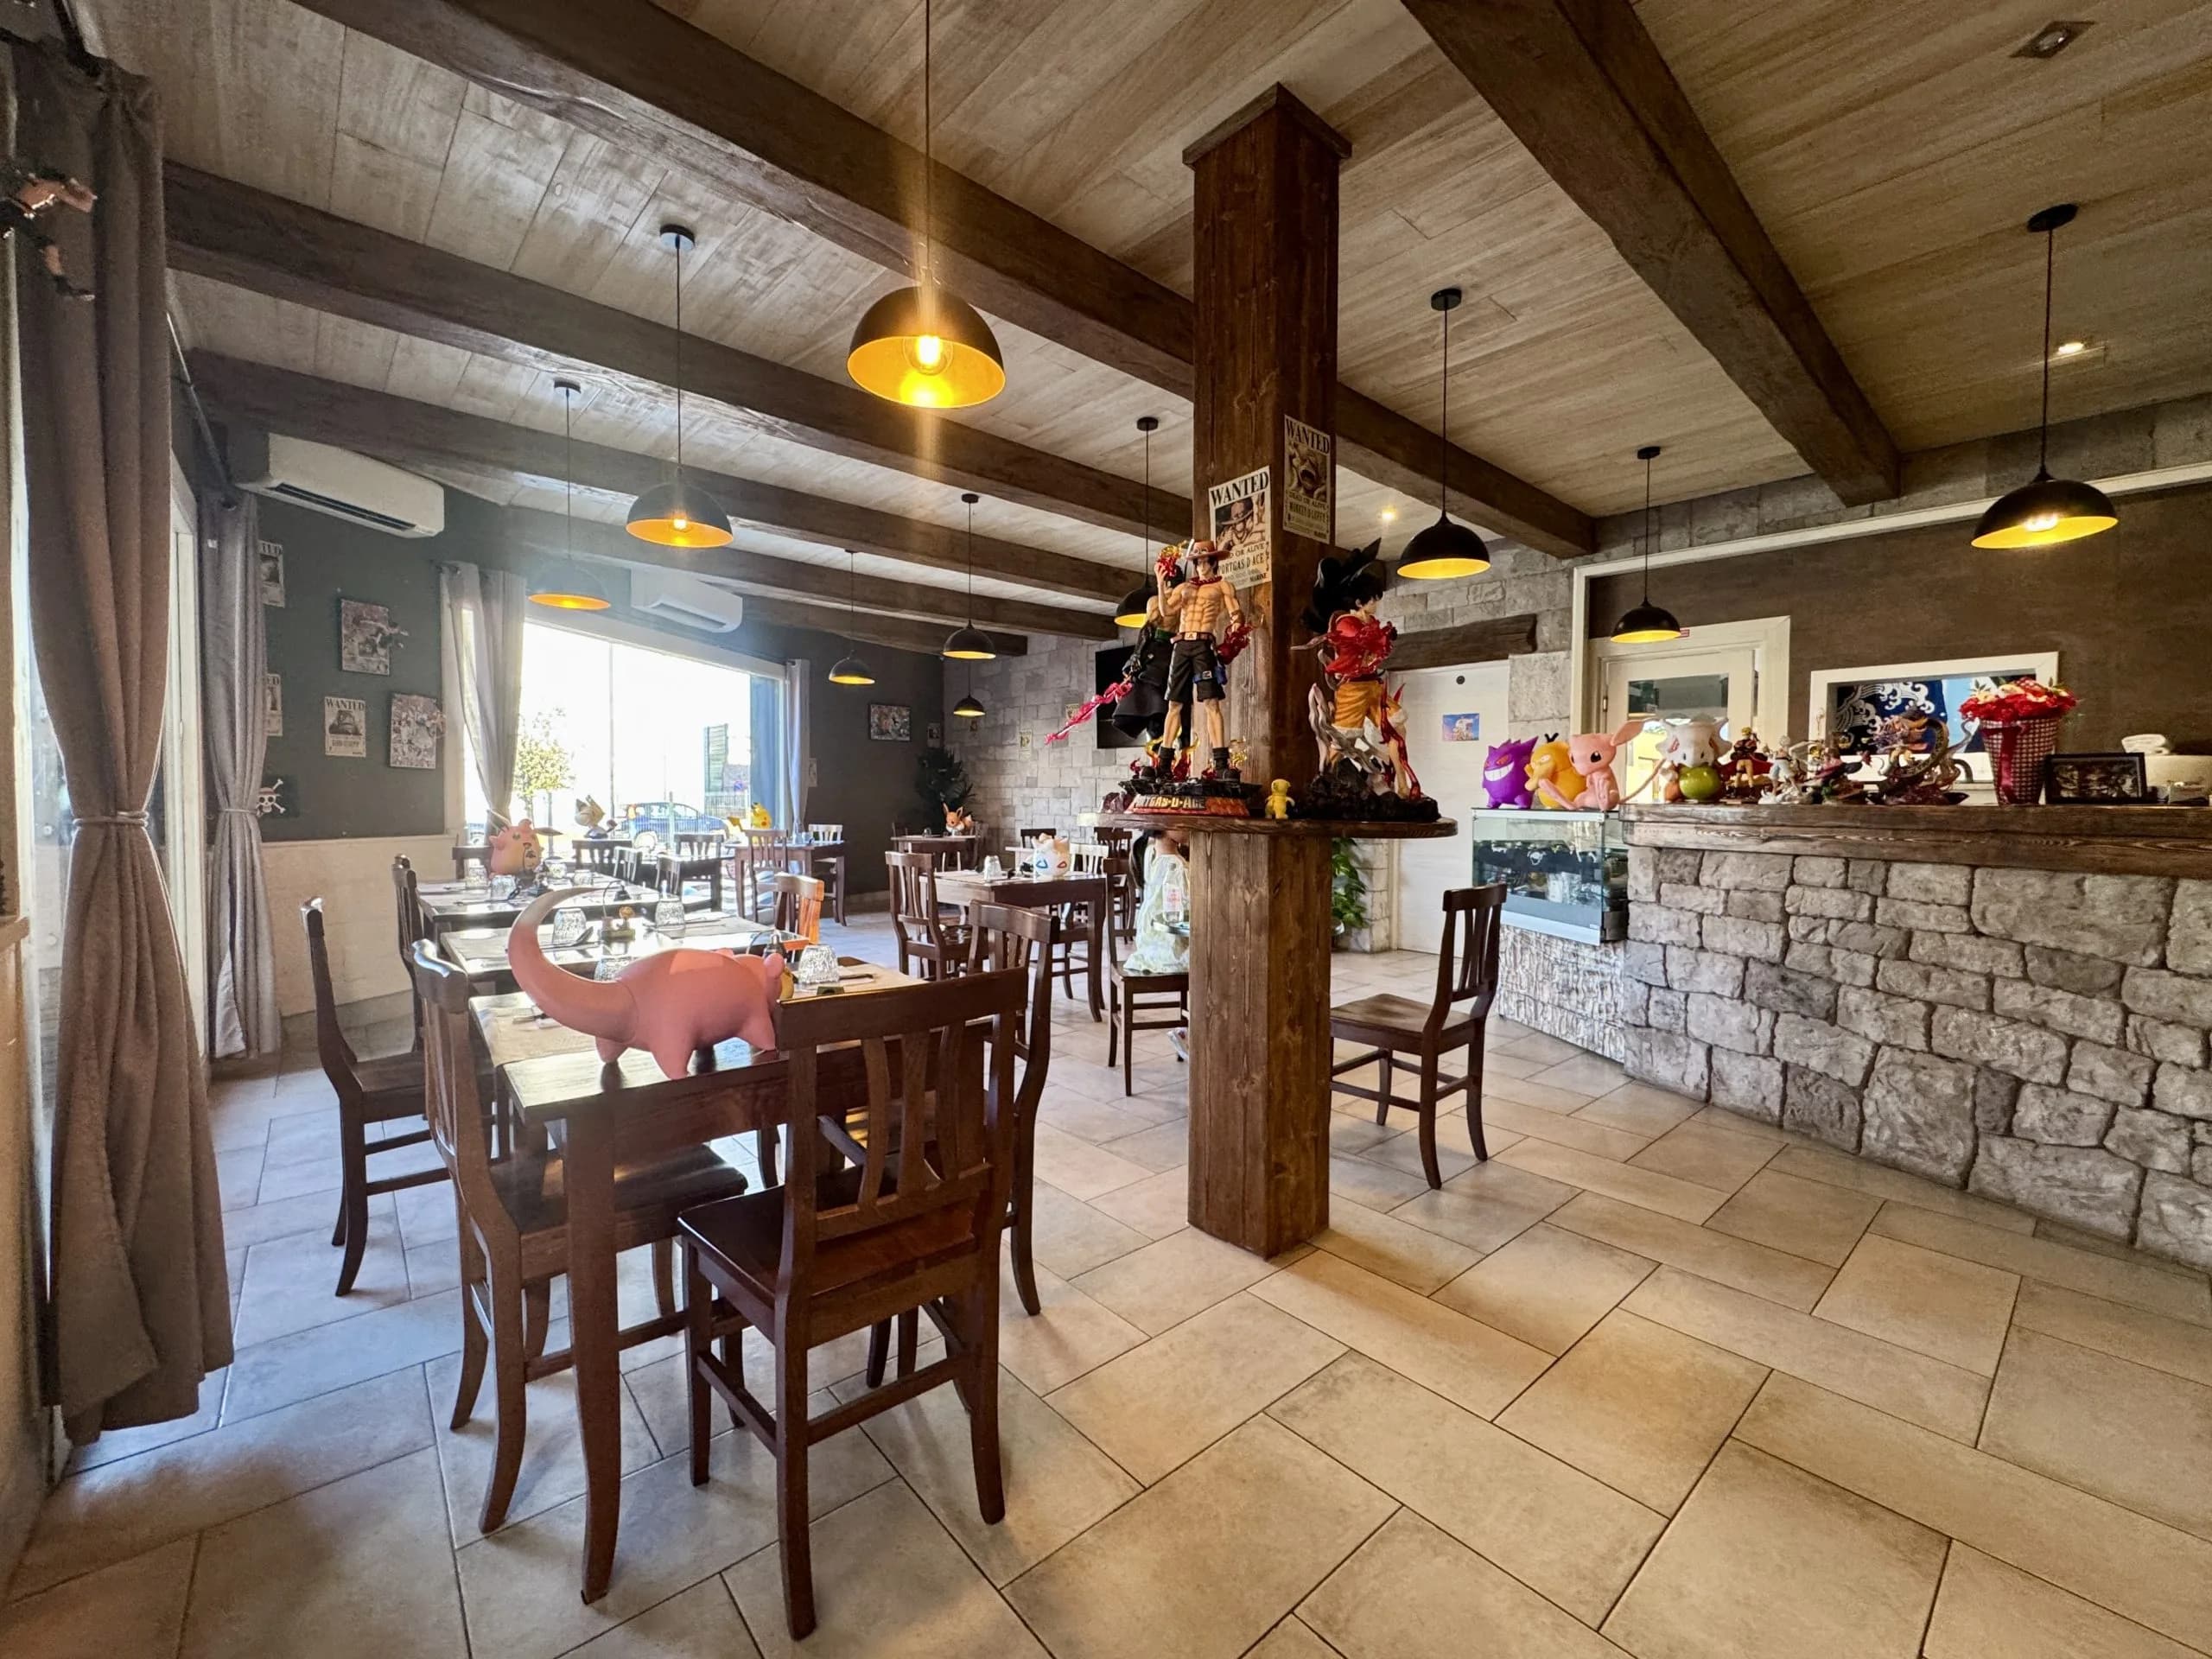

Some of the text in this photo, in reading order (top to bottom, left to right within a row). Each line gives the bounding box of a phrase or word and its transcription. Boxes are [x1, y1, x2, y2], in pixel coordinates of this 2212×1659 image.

[1286, 418, 1330, 454] WANTED
[1210, 471, 1269, 507] WANTED
[1236, 549, 1244, 557] OR
[1247, 543, 1264, 554] ALIVE
[1246, 556, 1251, 568] D
[1252, 552, 1264, 566] ACE
[326, 698, 365, 711] WANTED
